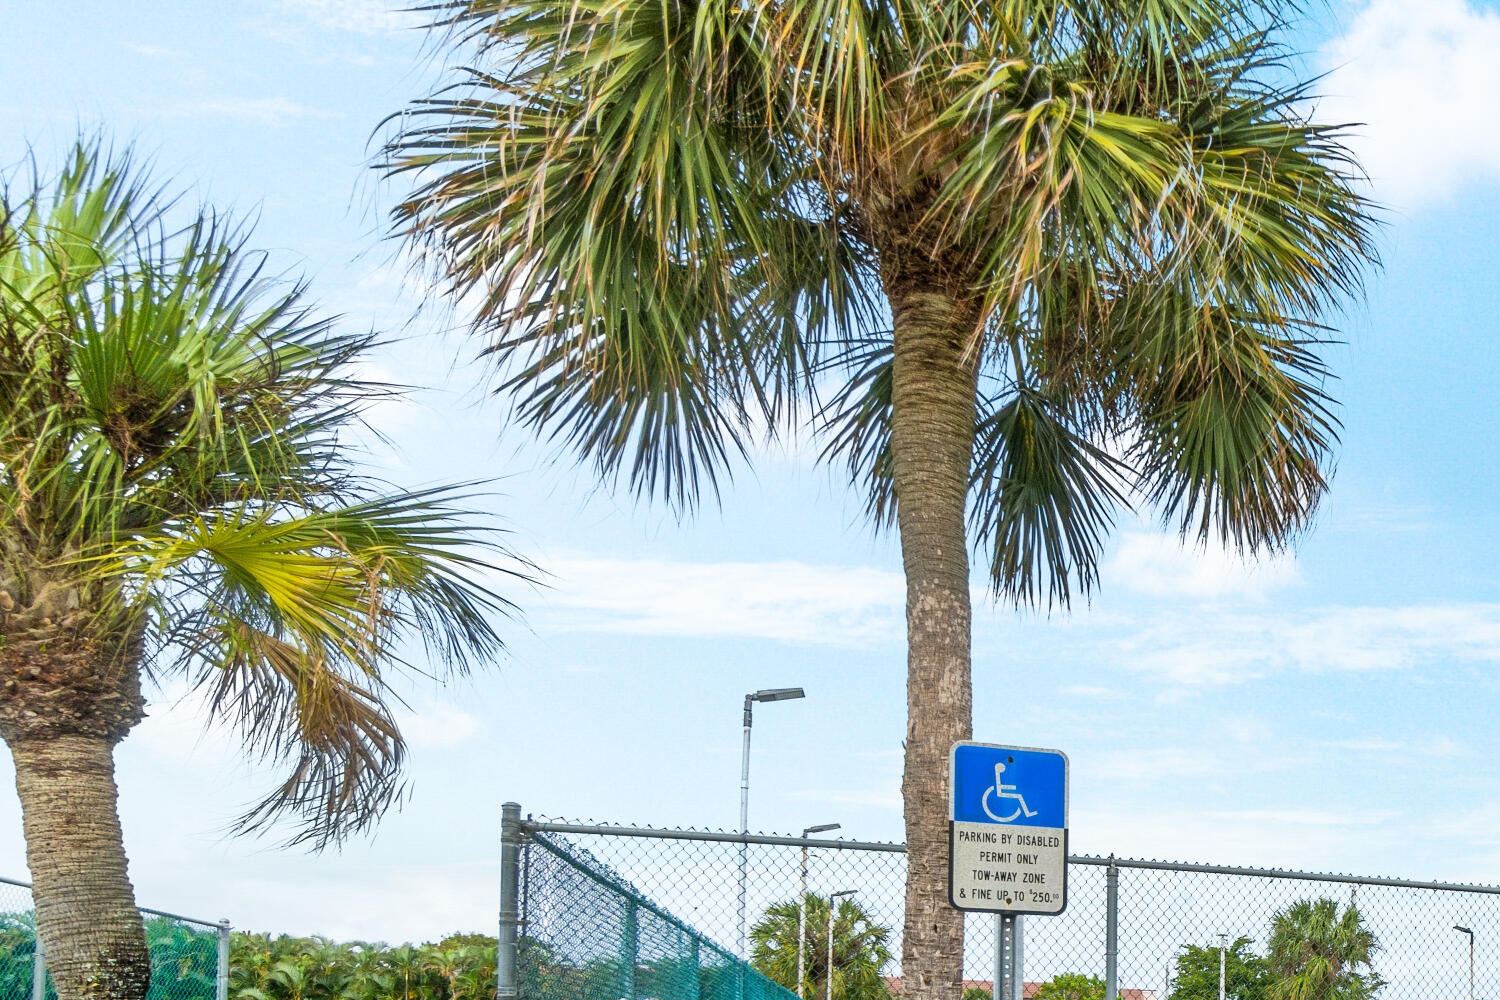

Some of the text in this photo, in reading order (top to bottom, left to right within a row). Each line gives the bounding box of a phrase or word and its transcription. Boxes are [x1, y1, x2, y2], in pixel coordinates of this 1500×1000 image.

[959, 831, 1059, 848] PARKING BY DISABLED
[980, 851, 1039, 865] PERMIT ONLY
[972, 870, 1046, 884] TOW-AWAY ZONE
[959, 888, 967, 899] &
[972, 888, 992, 900] FINE
[996, 890, 1009, 901] UP
[1014, 891, 1025, 902] TO
